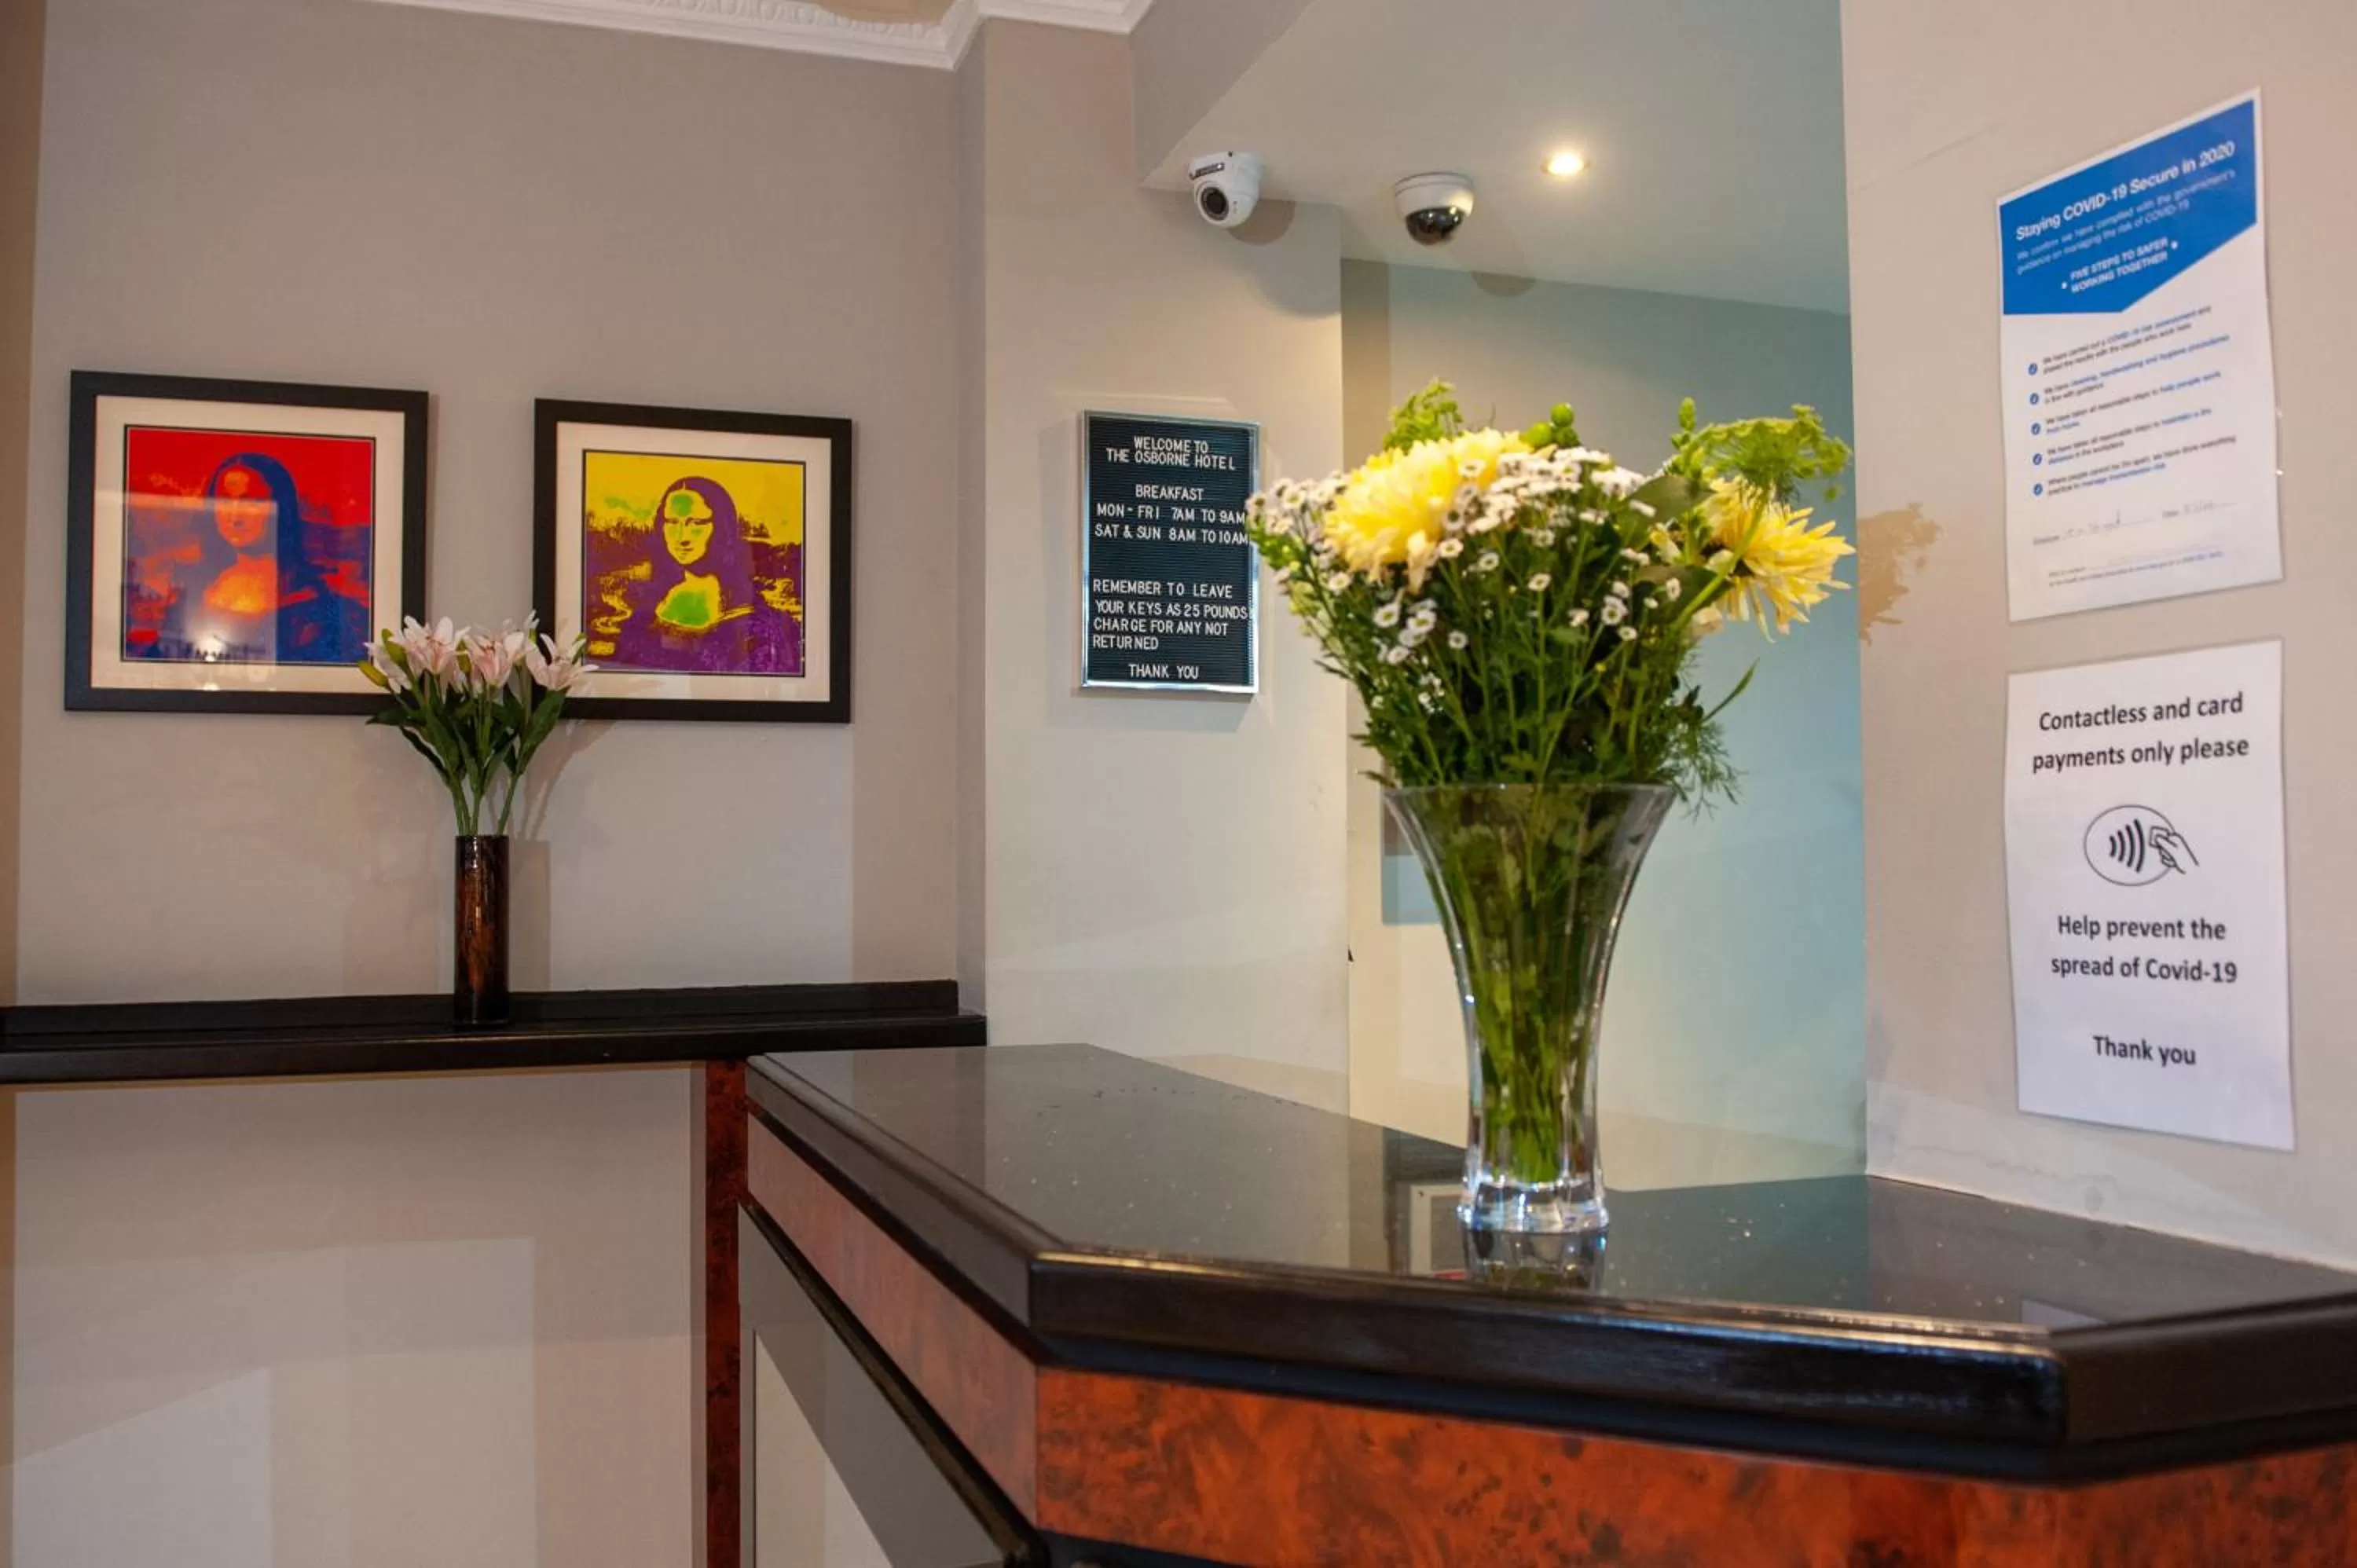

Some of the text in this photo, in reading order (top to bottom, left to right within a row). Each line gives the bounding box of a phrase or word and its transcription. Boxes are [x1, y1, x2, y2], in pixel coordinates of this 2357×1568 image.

[2016, 140, 2236, 240] Staying COVID-19 Secure in 2020
[2122, 249, 2135, 262] TO
[1134, 436, 1208, 454] WELCOME TO
[1106, 448, 1236, 471] THE OSBORNE HOTEL
[1135, 484, 1204, 501] BREAKFAST
[1138, 505, 1160, 519] FRI
[1171, 507, 1195, 522] 7AM
[1200, 508, 1216, 523] TO
[1219, 510, 1245, 524] 9AM
[1094, 522, 1248, 545] SAT & SUN 8AM TO 10AM
[1093, 579, 1233, 599] REMEMBER TO LEAVE
[1095, 599, 1248, 620] YOUR KEYS AS 25 POUNDS
[1093, 617, 1229, 636] CHARGE FOR ANY NOT
[1093, 634, 1159, 650] RETURNED
[1128, 664, 1199, 680] THANK YOU
[2039, 691, 2243, 731] Contactless and card
[2033, 738, 2249, 774] payments only please
[2058, 915, 2226, 940] Help prevent the
[2051, 956, 2238, 984] spread of Covid-19
[2092, 1035, 2197, 1068] Thank you
